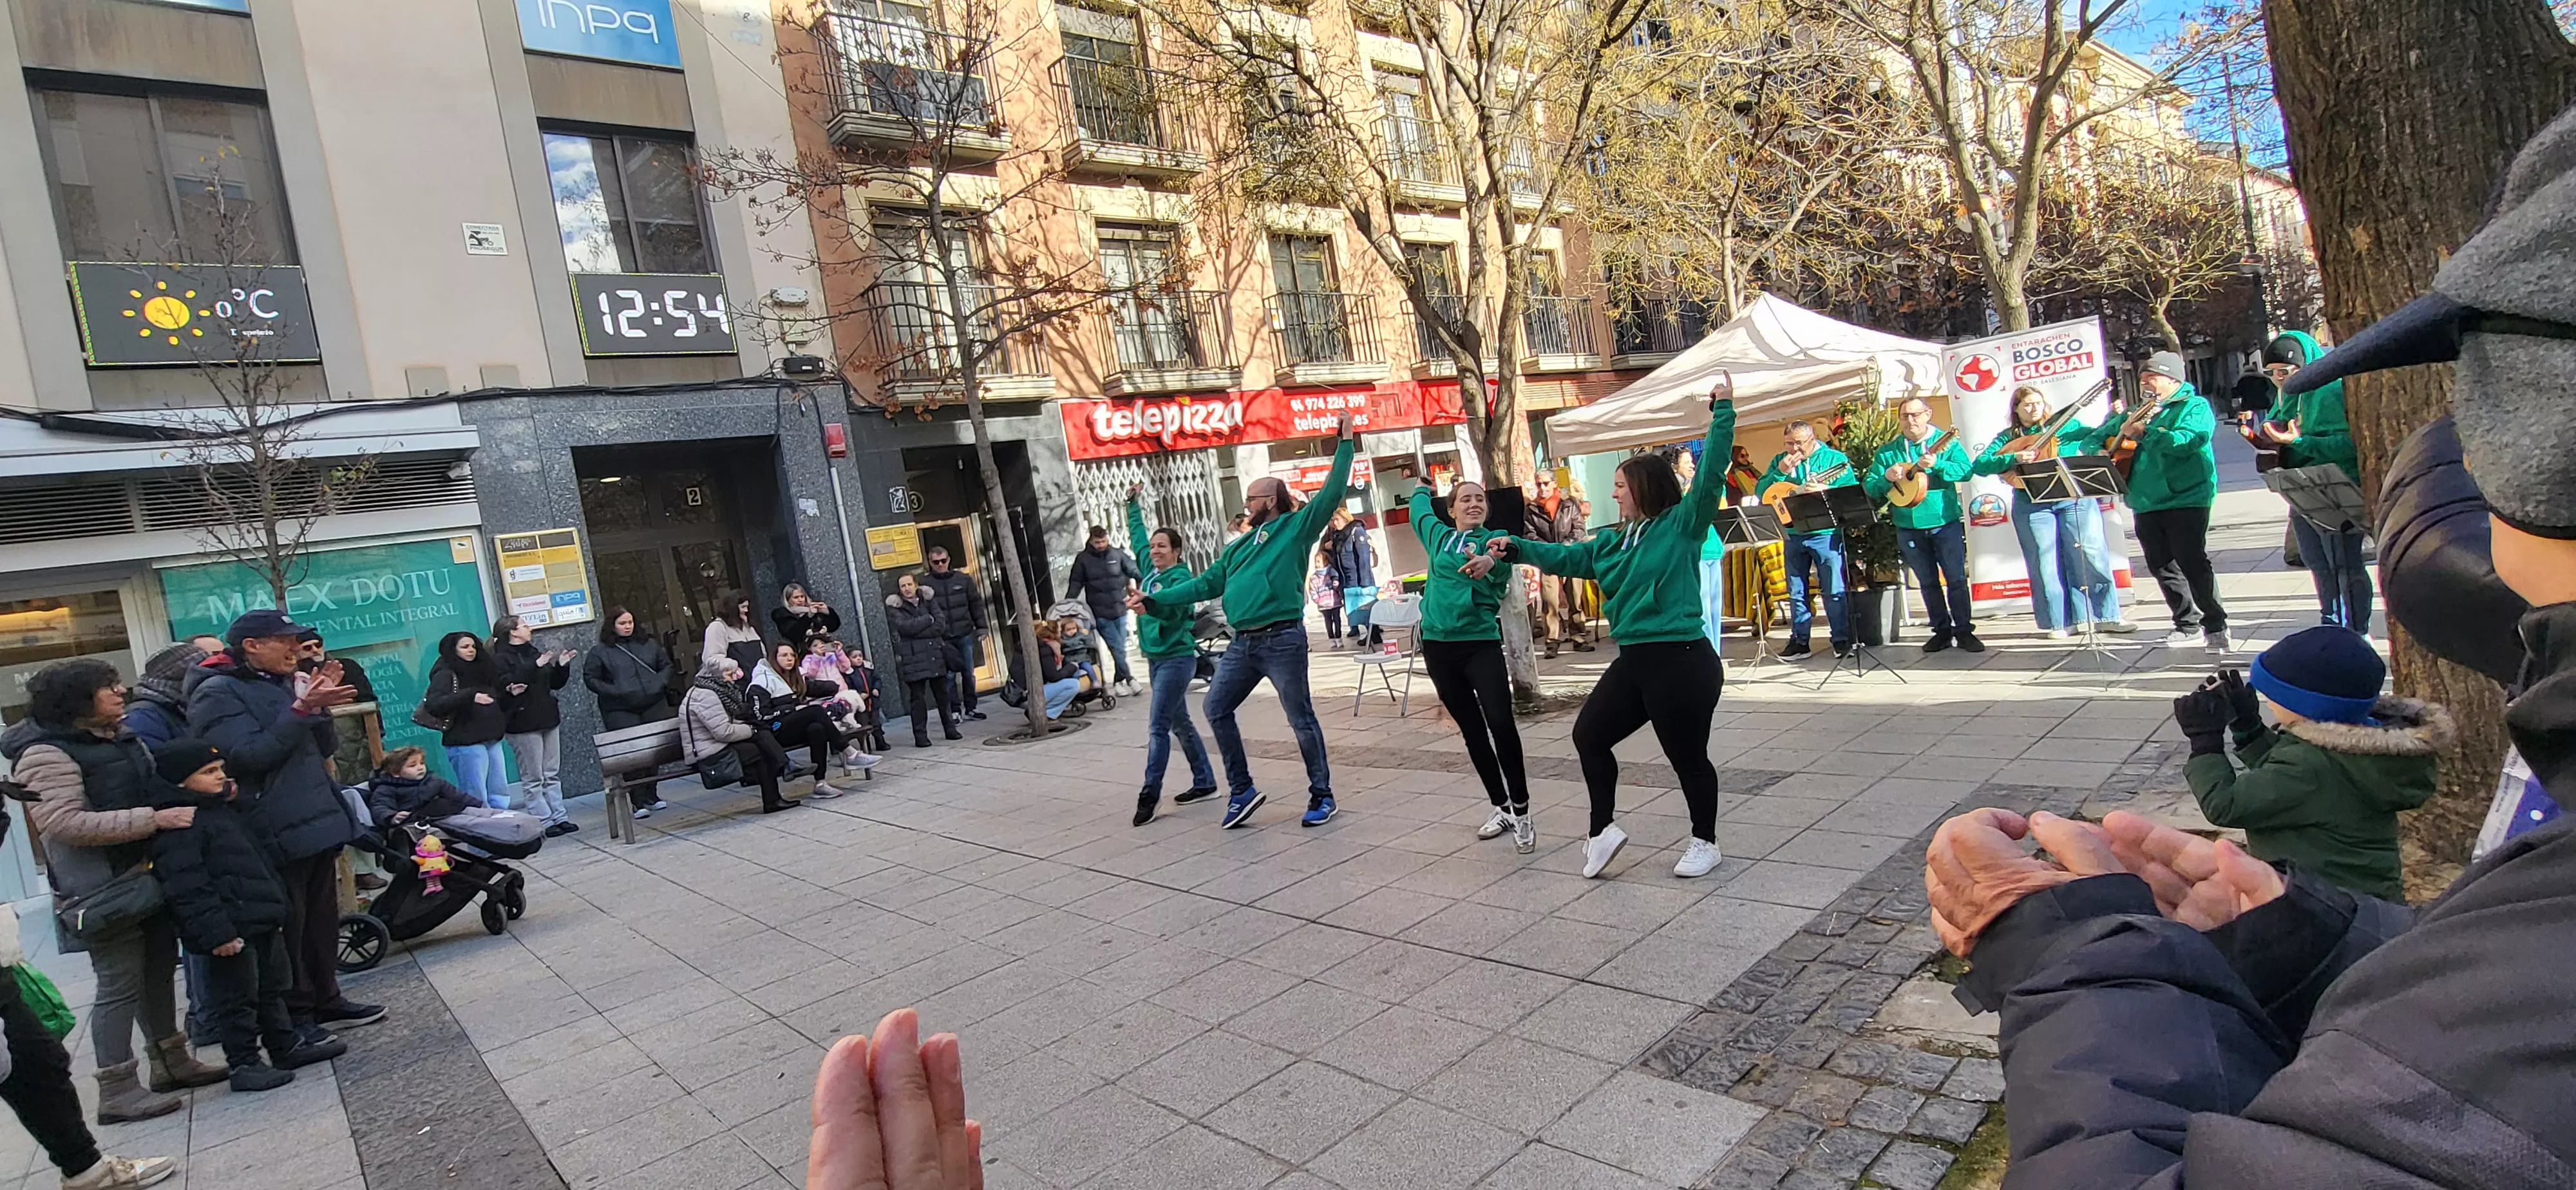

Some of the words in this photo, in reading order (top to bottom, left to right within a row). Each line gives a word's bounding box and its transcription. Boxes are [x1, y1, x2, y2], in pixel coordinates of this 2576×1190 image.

[598, 290, 730, 337] 12:54
[2012, 339, 2083, 363] BOSCO
[2014, 352, 2093, 380] GLOBAL
[2041, 374, 2077, 384] SALESIANA
[1305, 397, 1325, 410] 974
[1326, 395, 1346, 409] 226
[1347, 394, 1365, 408] 399
[1092, 397, 1245, 445] telepizza
[1293, 412, 1369, 433] telepiz.es
[689, 489, 699, 504] 2
[911, 495, 919, 509] 3
[352, 568, 451, 607] DOTU
[381, 602, 459, 625] INTEGRAL
